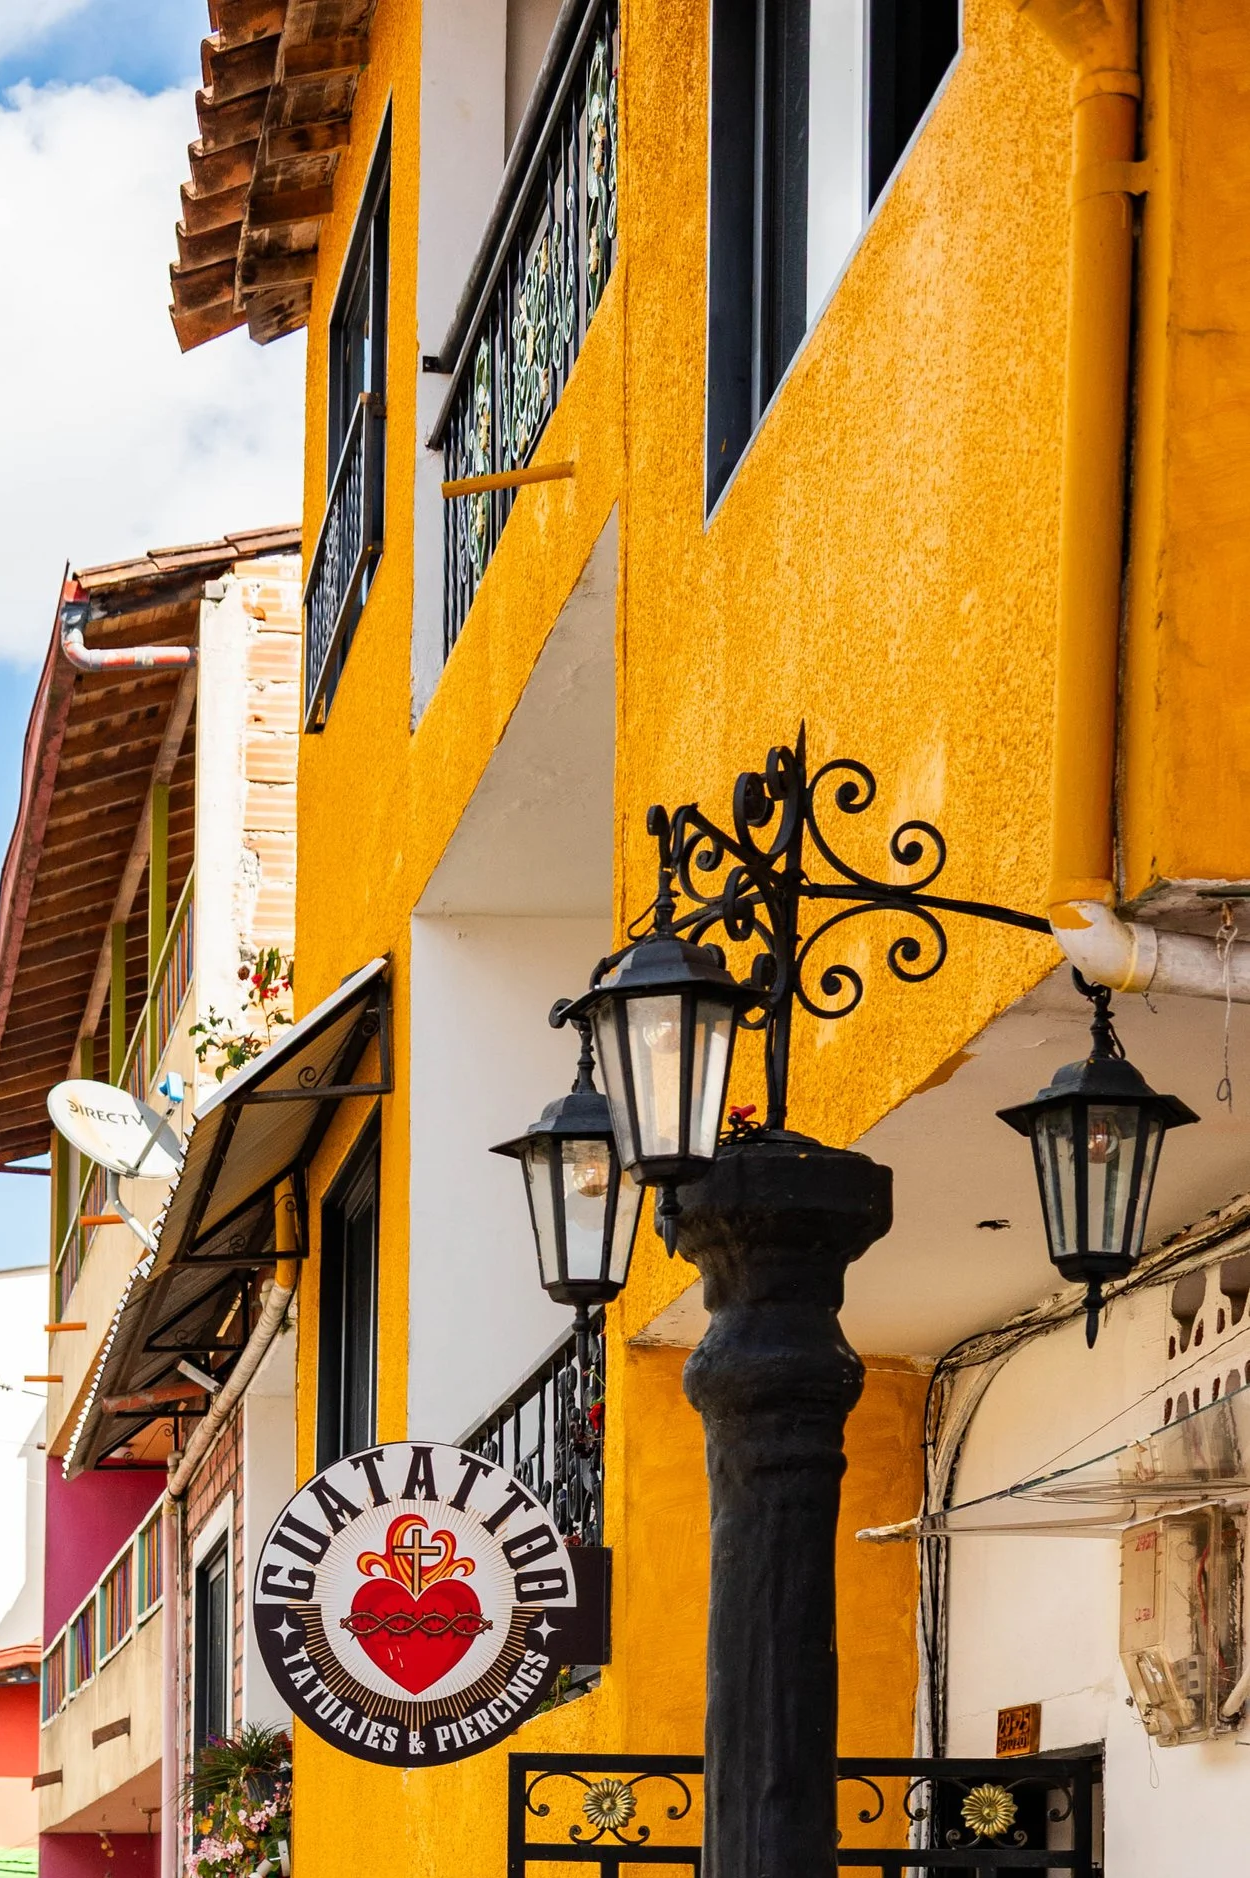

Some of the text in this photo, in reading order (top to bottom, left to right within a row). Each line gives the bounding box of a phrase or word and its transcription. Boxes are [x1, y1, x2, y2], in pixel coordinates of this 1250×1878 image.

[66, 1098, 144, 1127] DIRECTV
[260, 1445, 569, 1603] GUATATTOO
[282, 1645, 551, 1755] TATUAJES & PIERCINGS
